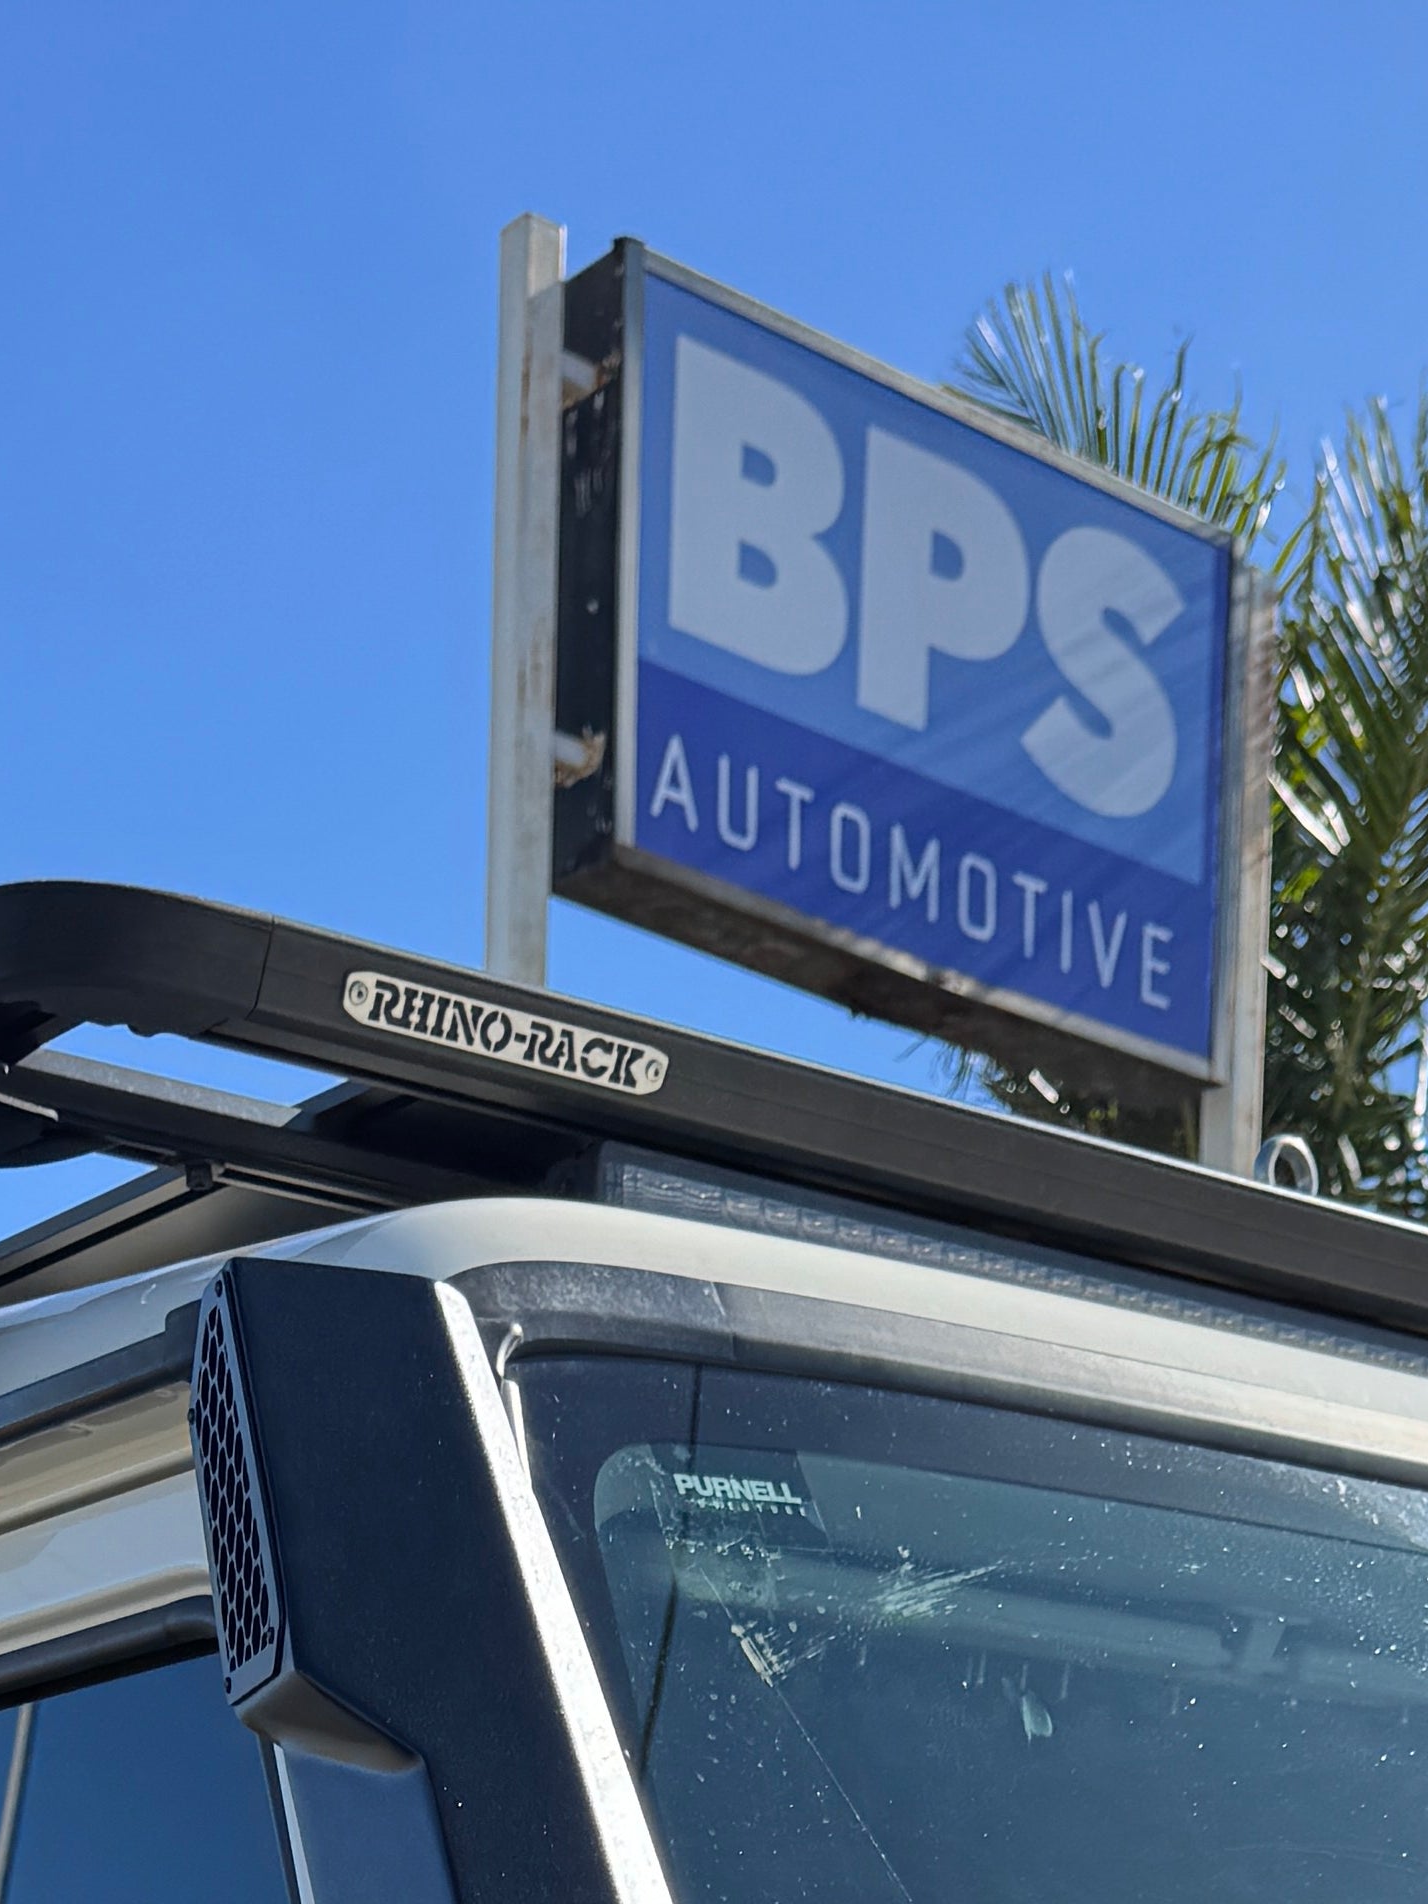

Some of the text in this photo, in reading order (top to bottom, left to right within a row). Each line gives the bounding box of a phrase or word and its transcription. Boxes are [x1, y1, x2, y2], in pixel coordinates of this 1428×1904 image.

[667, 332, 1187, 818] BPS
[649, 733, 1174, 1011] AUTOMOTIVE
[368, 979, 645, 1089] RHINO-RACK
[673, 1472, 802, 1505] PURNELL
